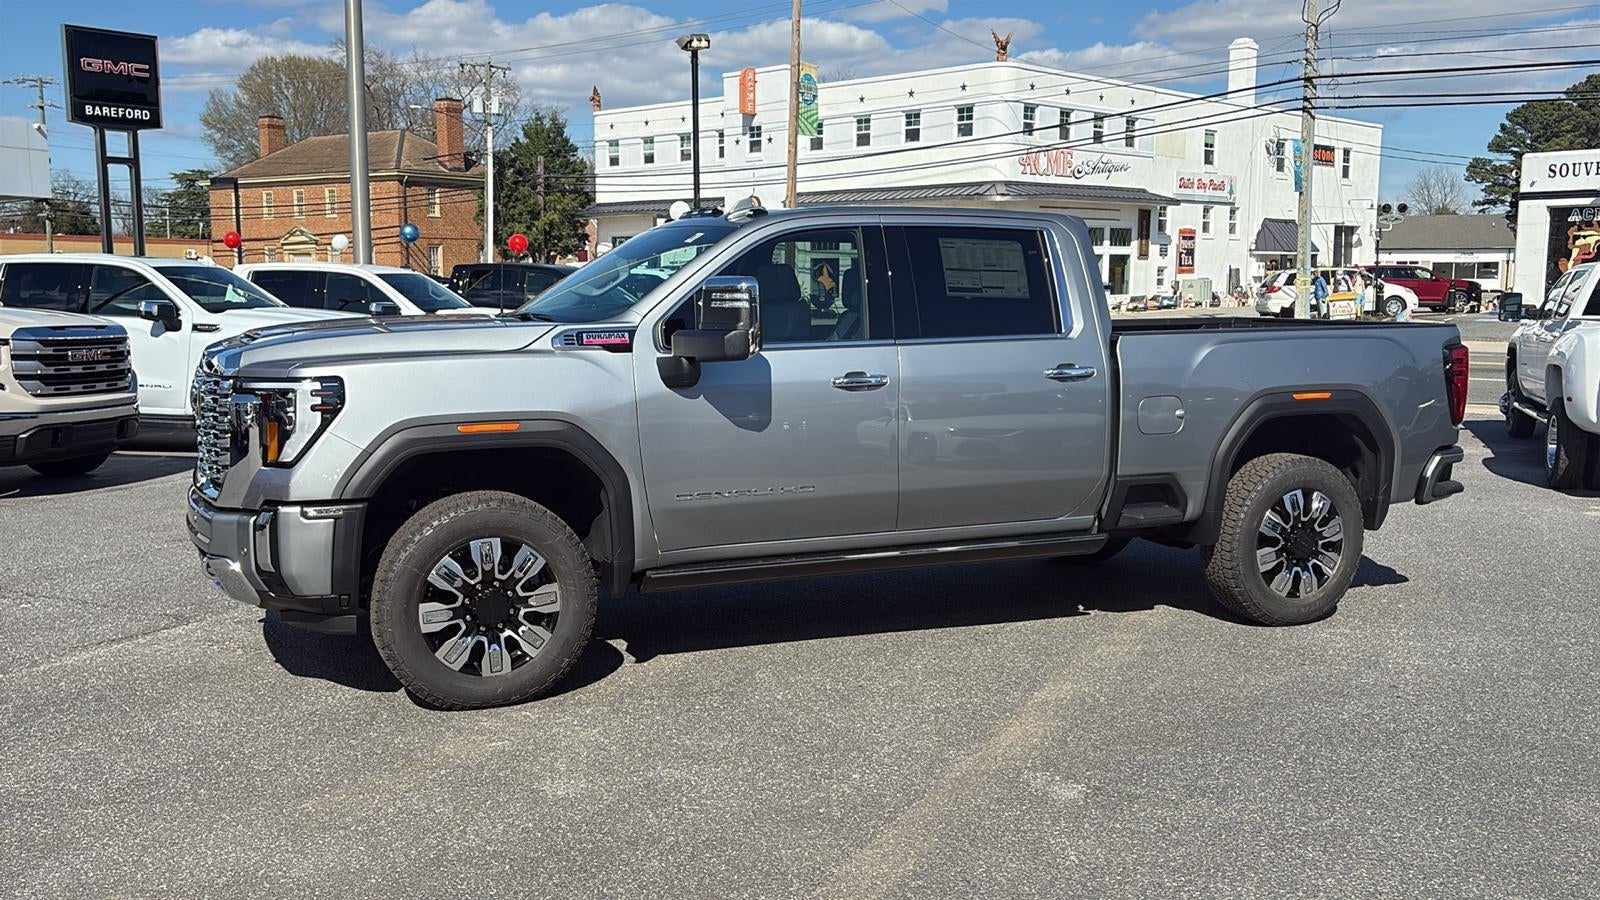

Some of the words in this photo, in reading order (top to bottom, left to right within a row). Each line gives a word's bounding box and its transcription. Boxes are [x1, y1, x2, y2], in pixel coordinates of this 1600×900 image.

[80, 57, 149, 77] GMC
[85, 105, 150, 120] BAREFORD
[1018, 149, 1073, 178] ACME
[1073, 153, 1131, 180] Antiques
[1181, 253, 1193, 265] TEA
[585, 332, 626, 340] DURAMAX
[67, 348, 111, 361] GMC
[675, 486, 774, 501] DENALI
